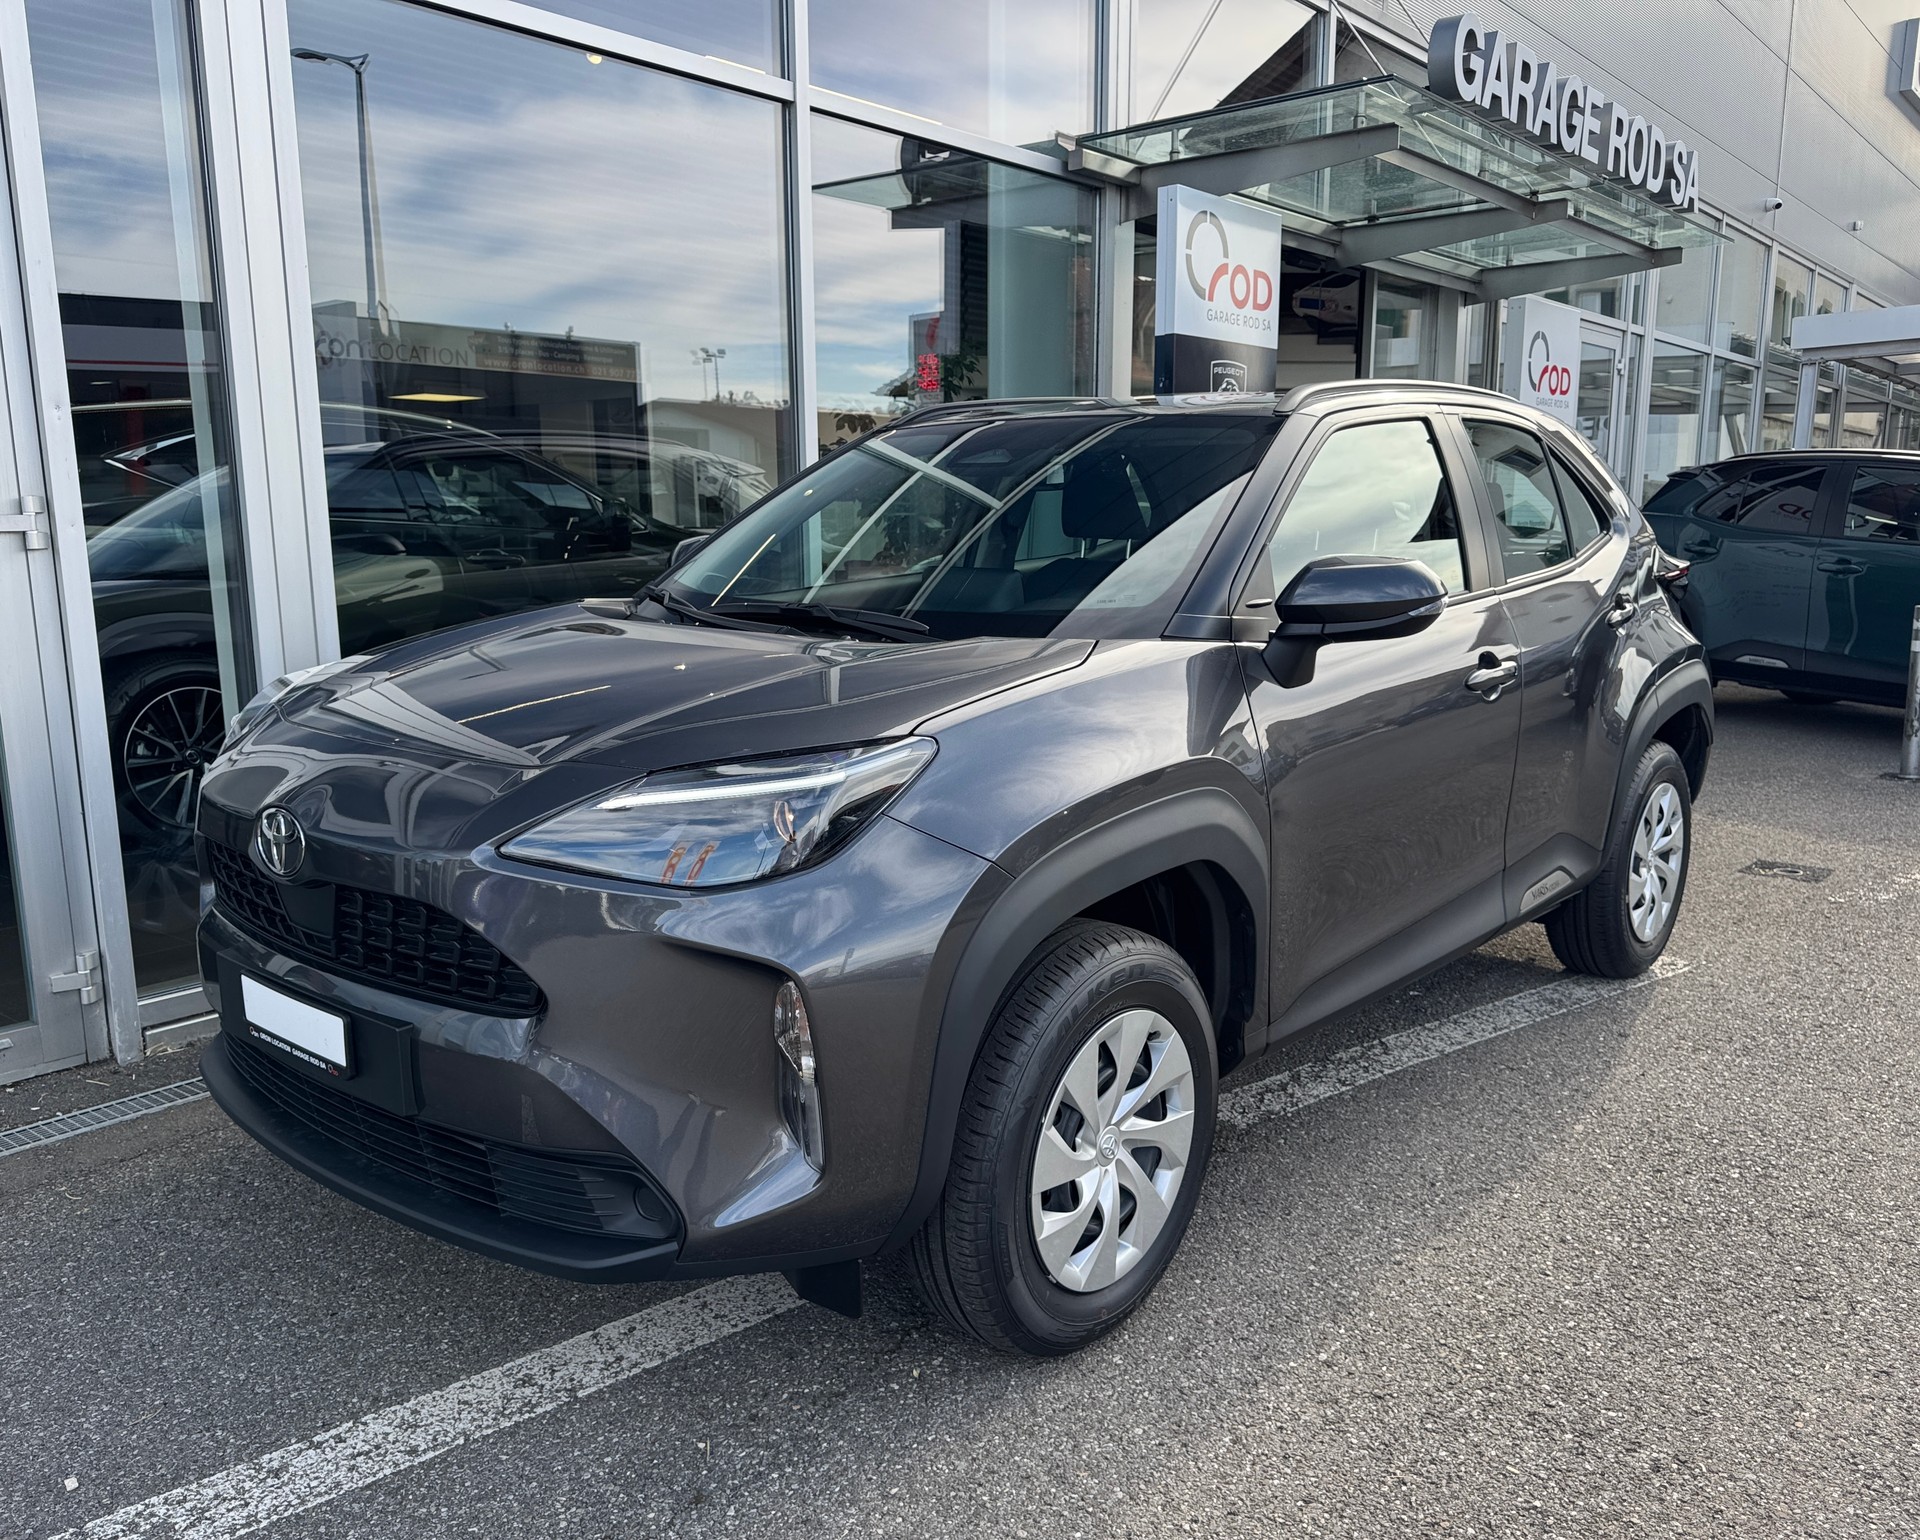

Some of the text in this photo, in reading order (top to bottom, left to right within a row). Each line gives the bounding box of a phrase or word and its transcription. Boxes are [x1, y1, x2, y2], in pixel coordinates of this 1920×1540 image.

[1453, 12, 1699, 213] GARAGE ROD SA
[1206, 308, 1271, 331] GARAGE ROD SA
[1213, 366, 1244, 377] PEUGEOT
[260, 1032, 272, 1043] ORON
[272, 1038, 291, 1053] LOCATION
[292, 1048, 310, 1062] GARAGE
[310, 1057, 319, 1066] ROD
[319, 1061, 327, 1070] SA
